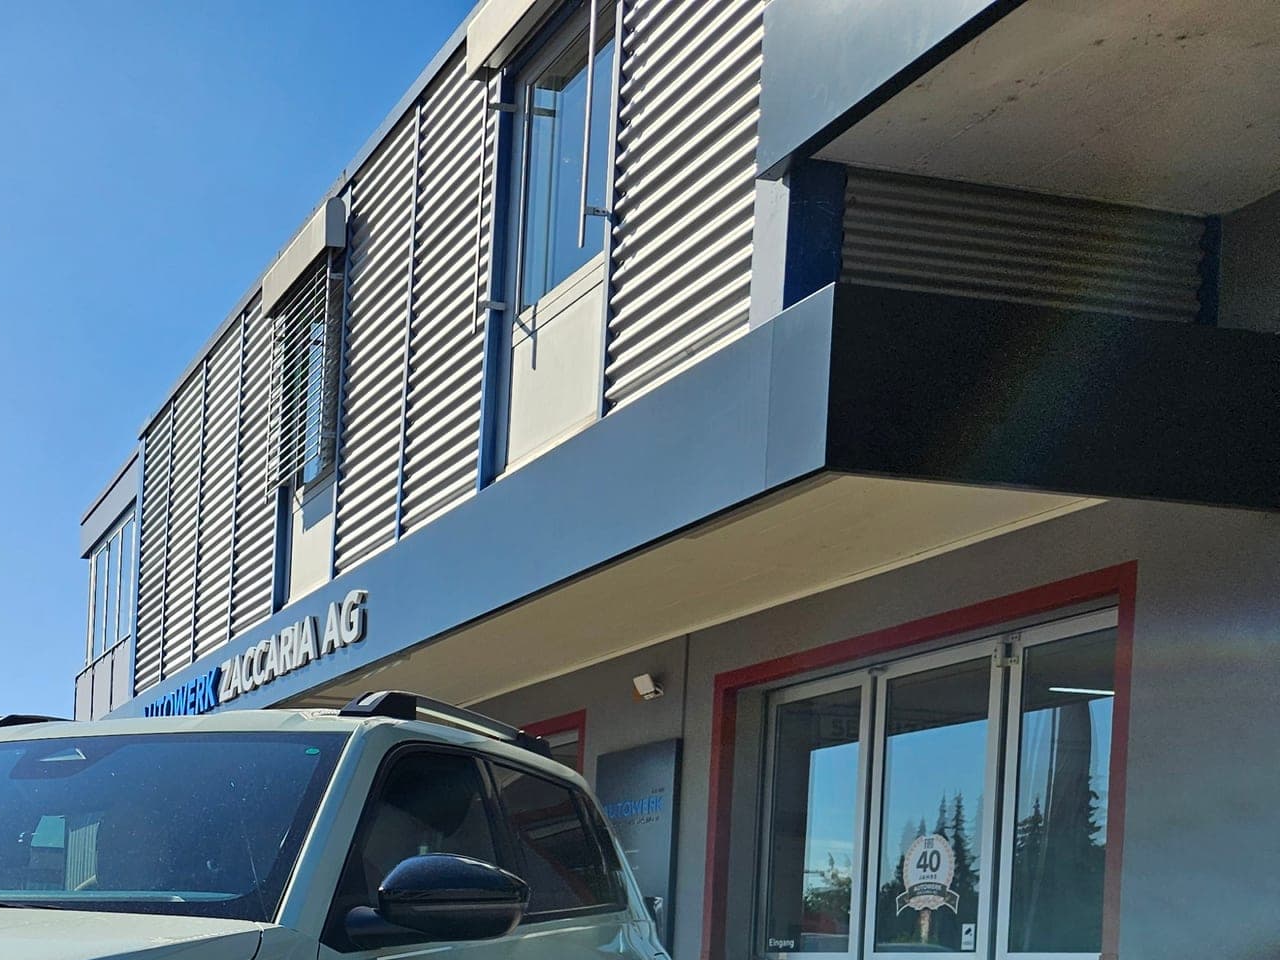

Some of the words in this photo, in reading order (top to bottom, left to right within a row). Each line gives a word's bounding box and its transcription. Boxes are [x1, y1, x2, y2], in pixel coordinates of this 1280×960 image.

[219, 615, 321, 703] ZACCARIA
[321, 589, 370, 656] AG
[916, 850, 941, 873] 40
[768, 938, 795, 949] Eingang
